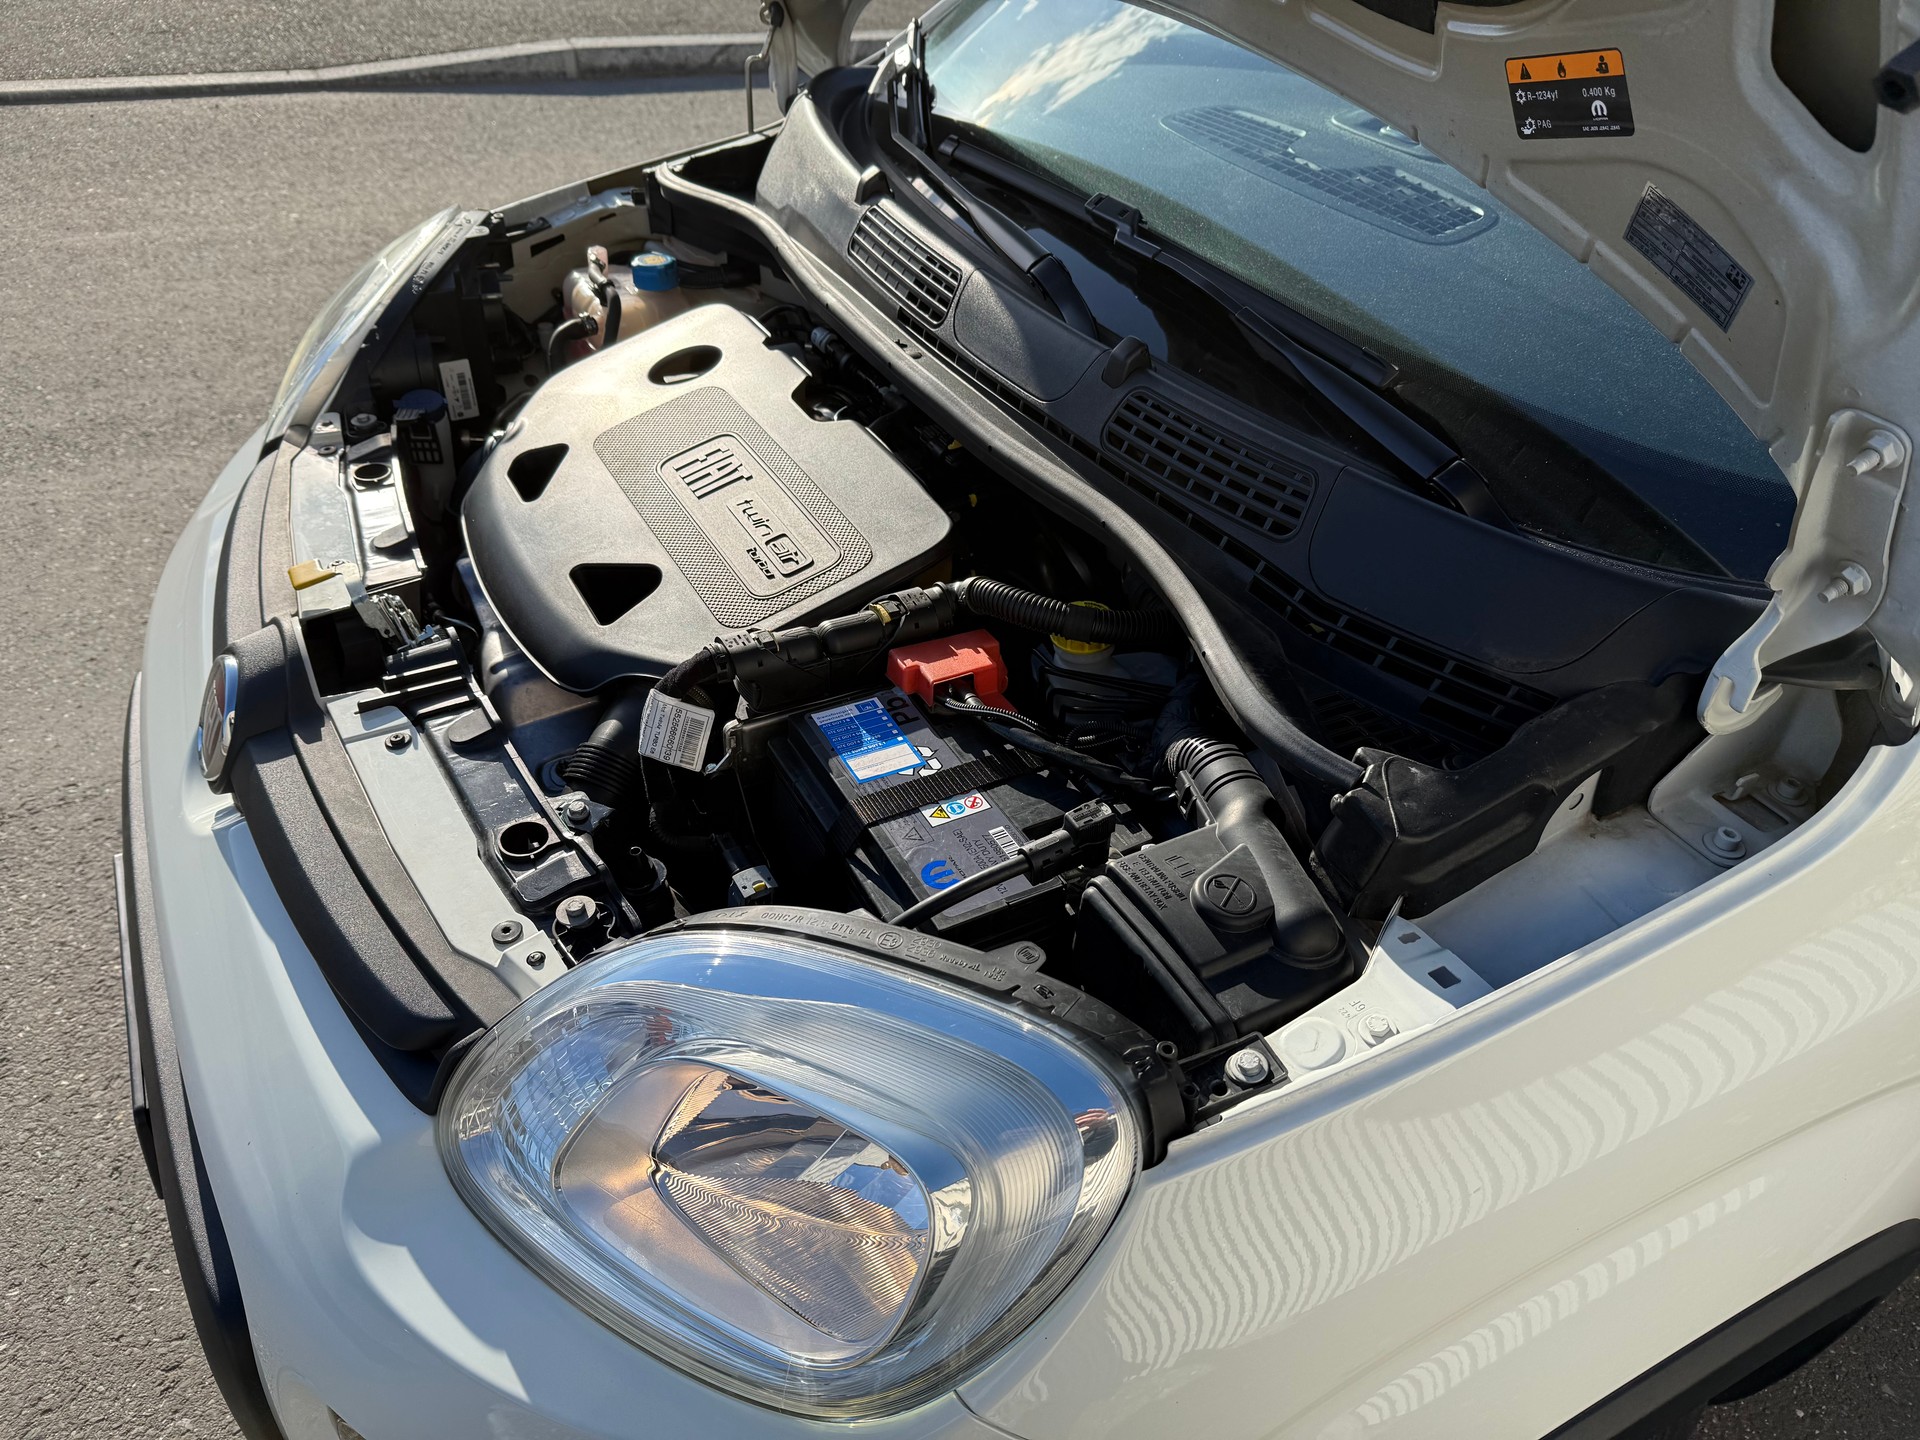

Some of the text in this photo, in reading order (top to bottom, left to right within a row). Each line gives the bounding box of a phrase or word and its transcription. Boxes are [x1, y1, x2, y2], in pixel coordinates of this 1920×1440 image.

[1582, 86, 1616, 97] 0.400 Kg
[1537, 119, 1552, 129] PAG
[673, 448, 753, 500] FIAT
[973, 839, 991, 859] DUTY
[858, 928, 874, 940] PL
